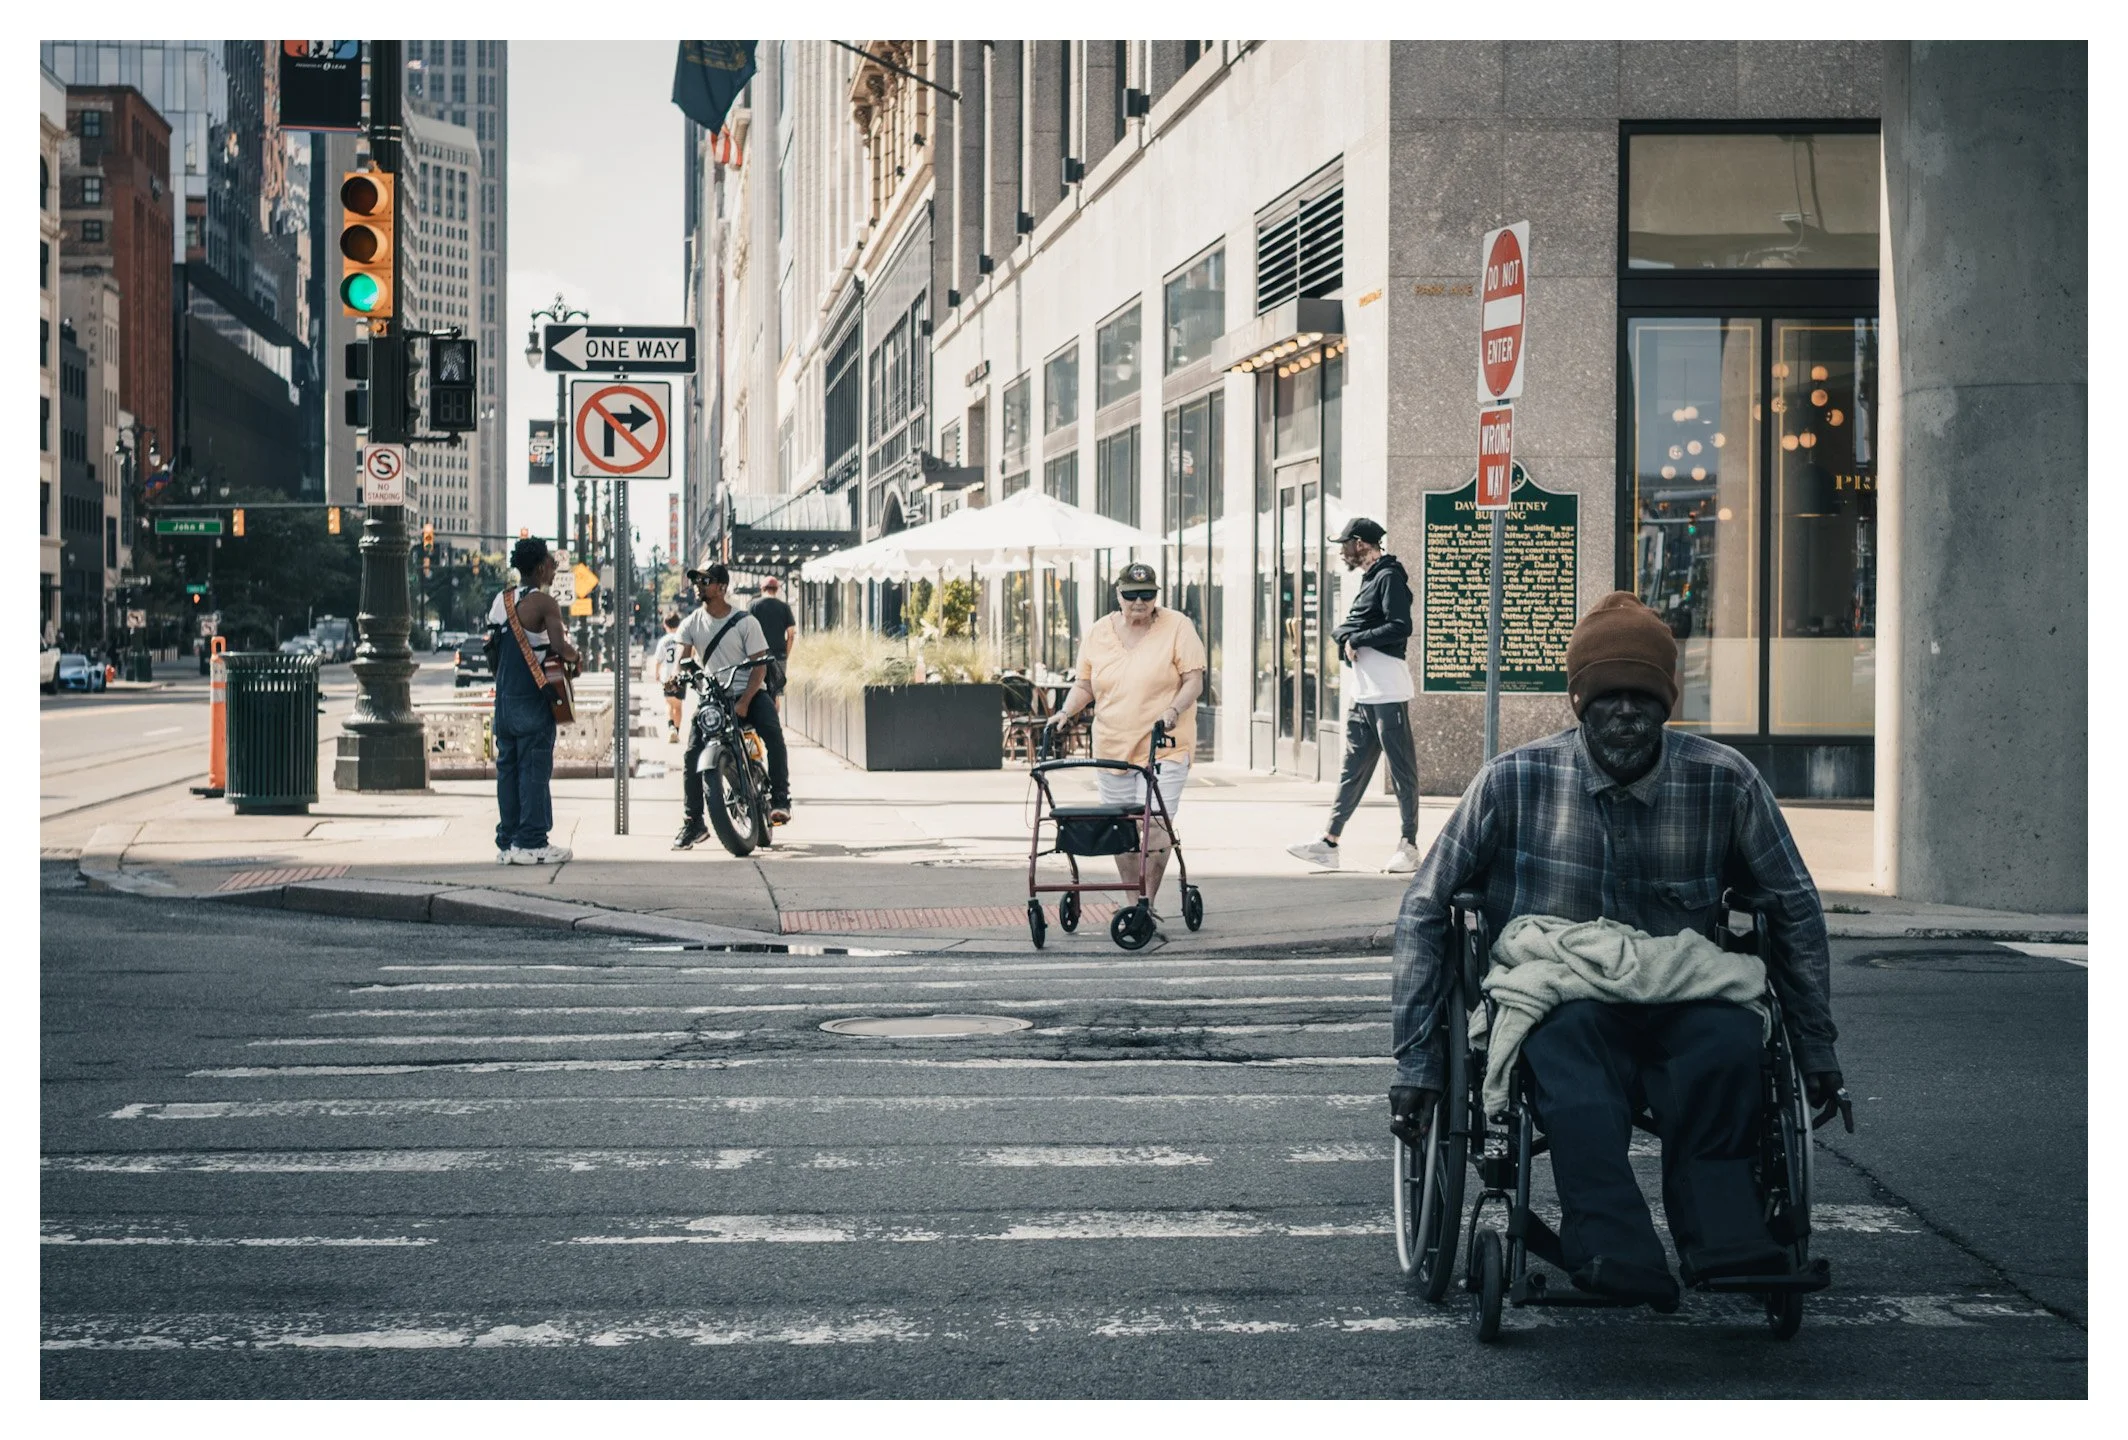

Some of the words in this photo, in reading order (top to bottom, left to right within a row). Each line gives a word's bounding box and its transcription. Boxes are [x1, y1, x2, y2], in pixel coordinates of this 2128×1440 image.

[1487, 266, 1499, 291] DO
[1501, 259, 1520, 288] NOT
[586, 340, 629, 358] ONE
[637, 340, 679, 359] WAY
[1487, 336, 1513, 365] ENTER
[1481, 422, 1511, 455] WRONG
[377, 483, 390, 491] NO
[1487, 465, 1505, 497] WAY
[367, 492, 400, 501] STANDING
[1454, 501, 1476, 511] DAV
[172, 522, 196, 532] John
[553, 590, 573, 601] 25
[666, 647, 675, 663] 3
